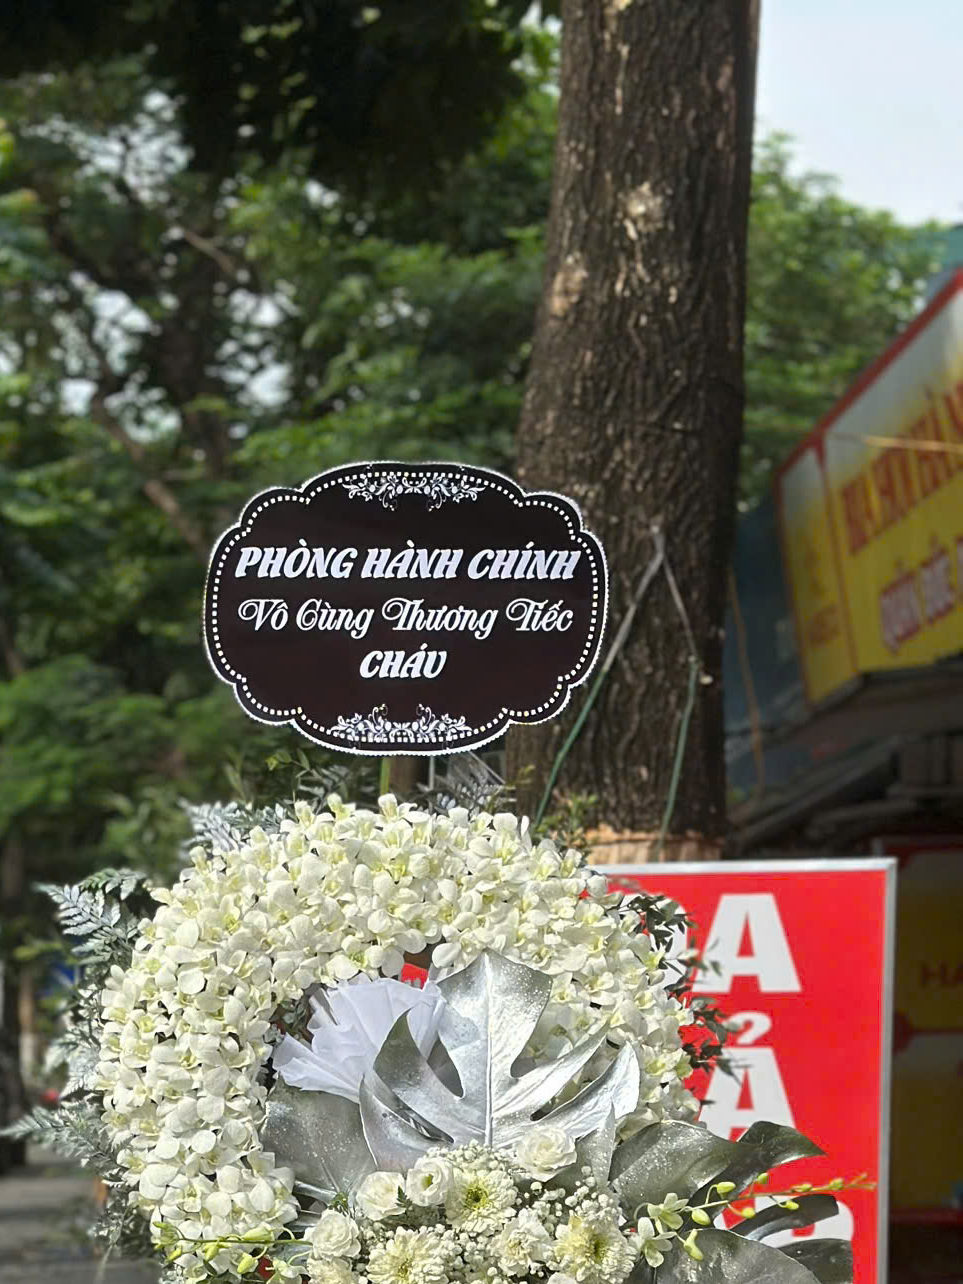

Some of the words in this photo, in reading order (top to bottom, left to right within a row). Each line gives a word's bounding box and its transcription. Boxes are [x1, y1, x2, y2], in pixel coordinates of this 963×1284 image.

[235, 538, 358, 579] PHÒNG
[360, 539, 464, 580] HÀNH
[467, 541, 581, 580] CHÍNH
[238, 599, 288, 632] Vô
[296, 598, 374, 640] Cùng
[382, 597, 499, 640] Thương
[506, 598, 574, 633] Tiếc
[359, 643, 448, 679] CHÁU
